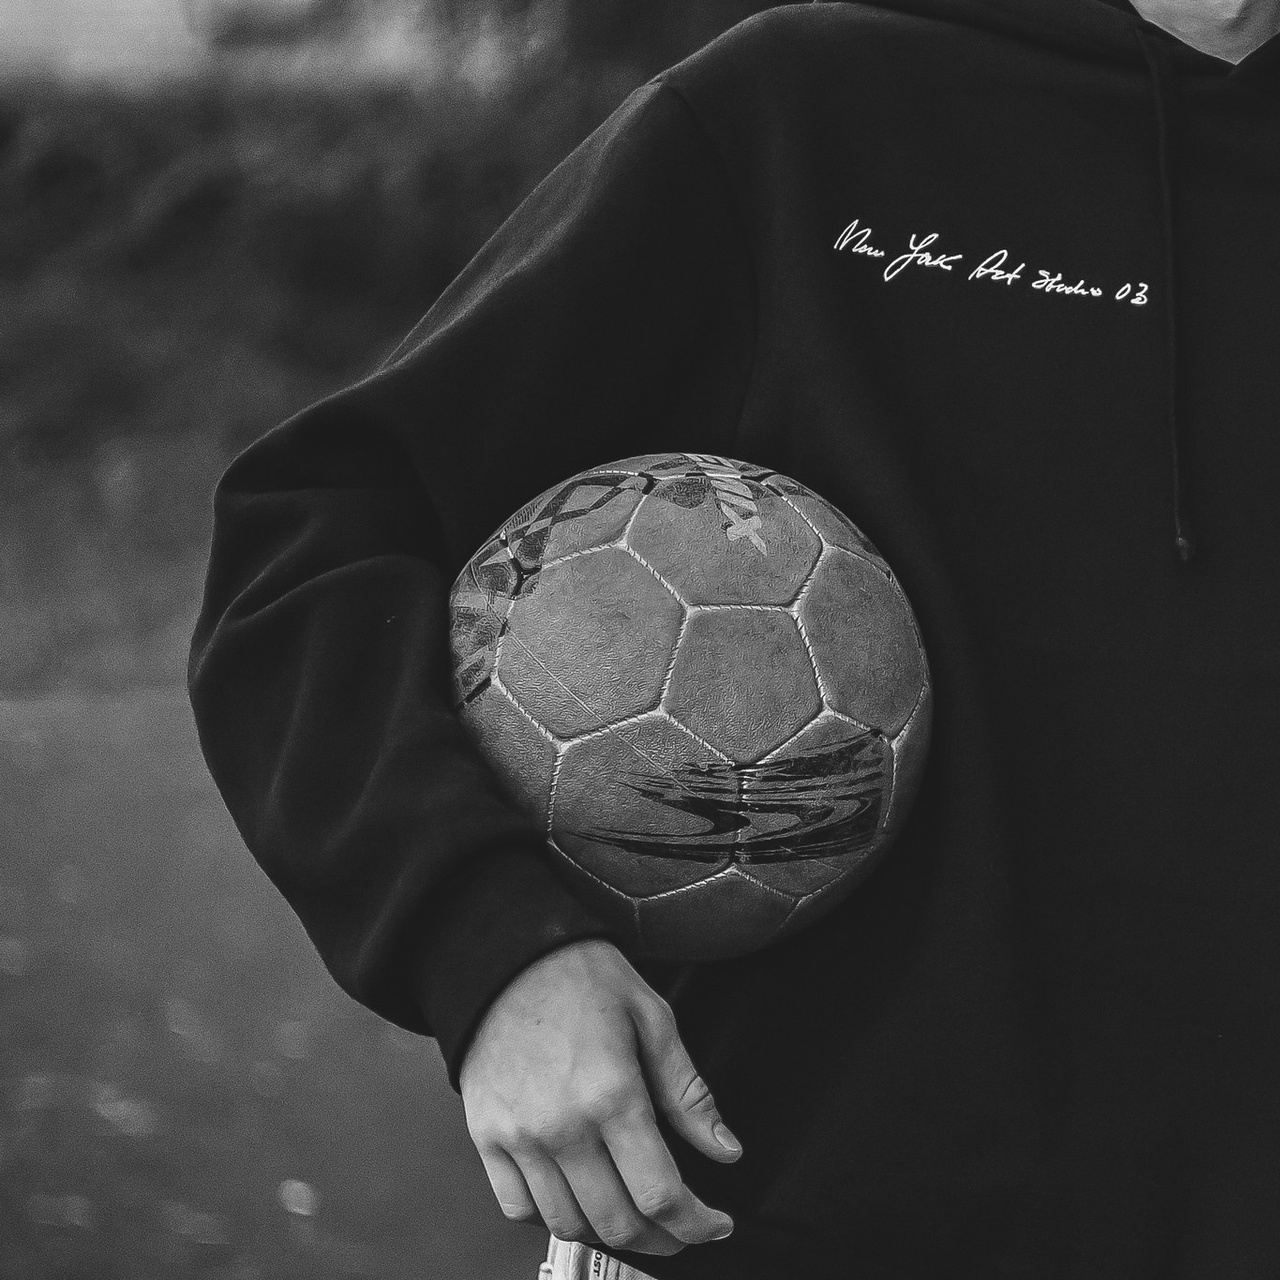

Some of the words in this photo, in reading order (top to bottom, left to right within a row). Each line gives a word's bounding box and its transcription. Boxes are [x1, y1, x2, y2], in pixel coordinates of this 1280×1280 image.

[883, 232, 963, 282] York
[967, 249, 1026, 286] Art
[1031, 269, 1103, 297] Studio
[1114, 282, 1149, 306] 03
